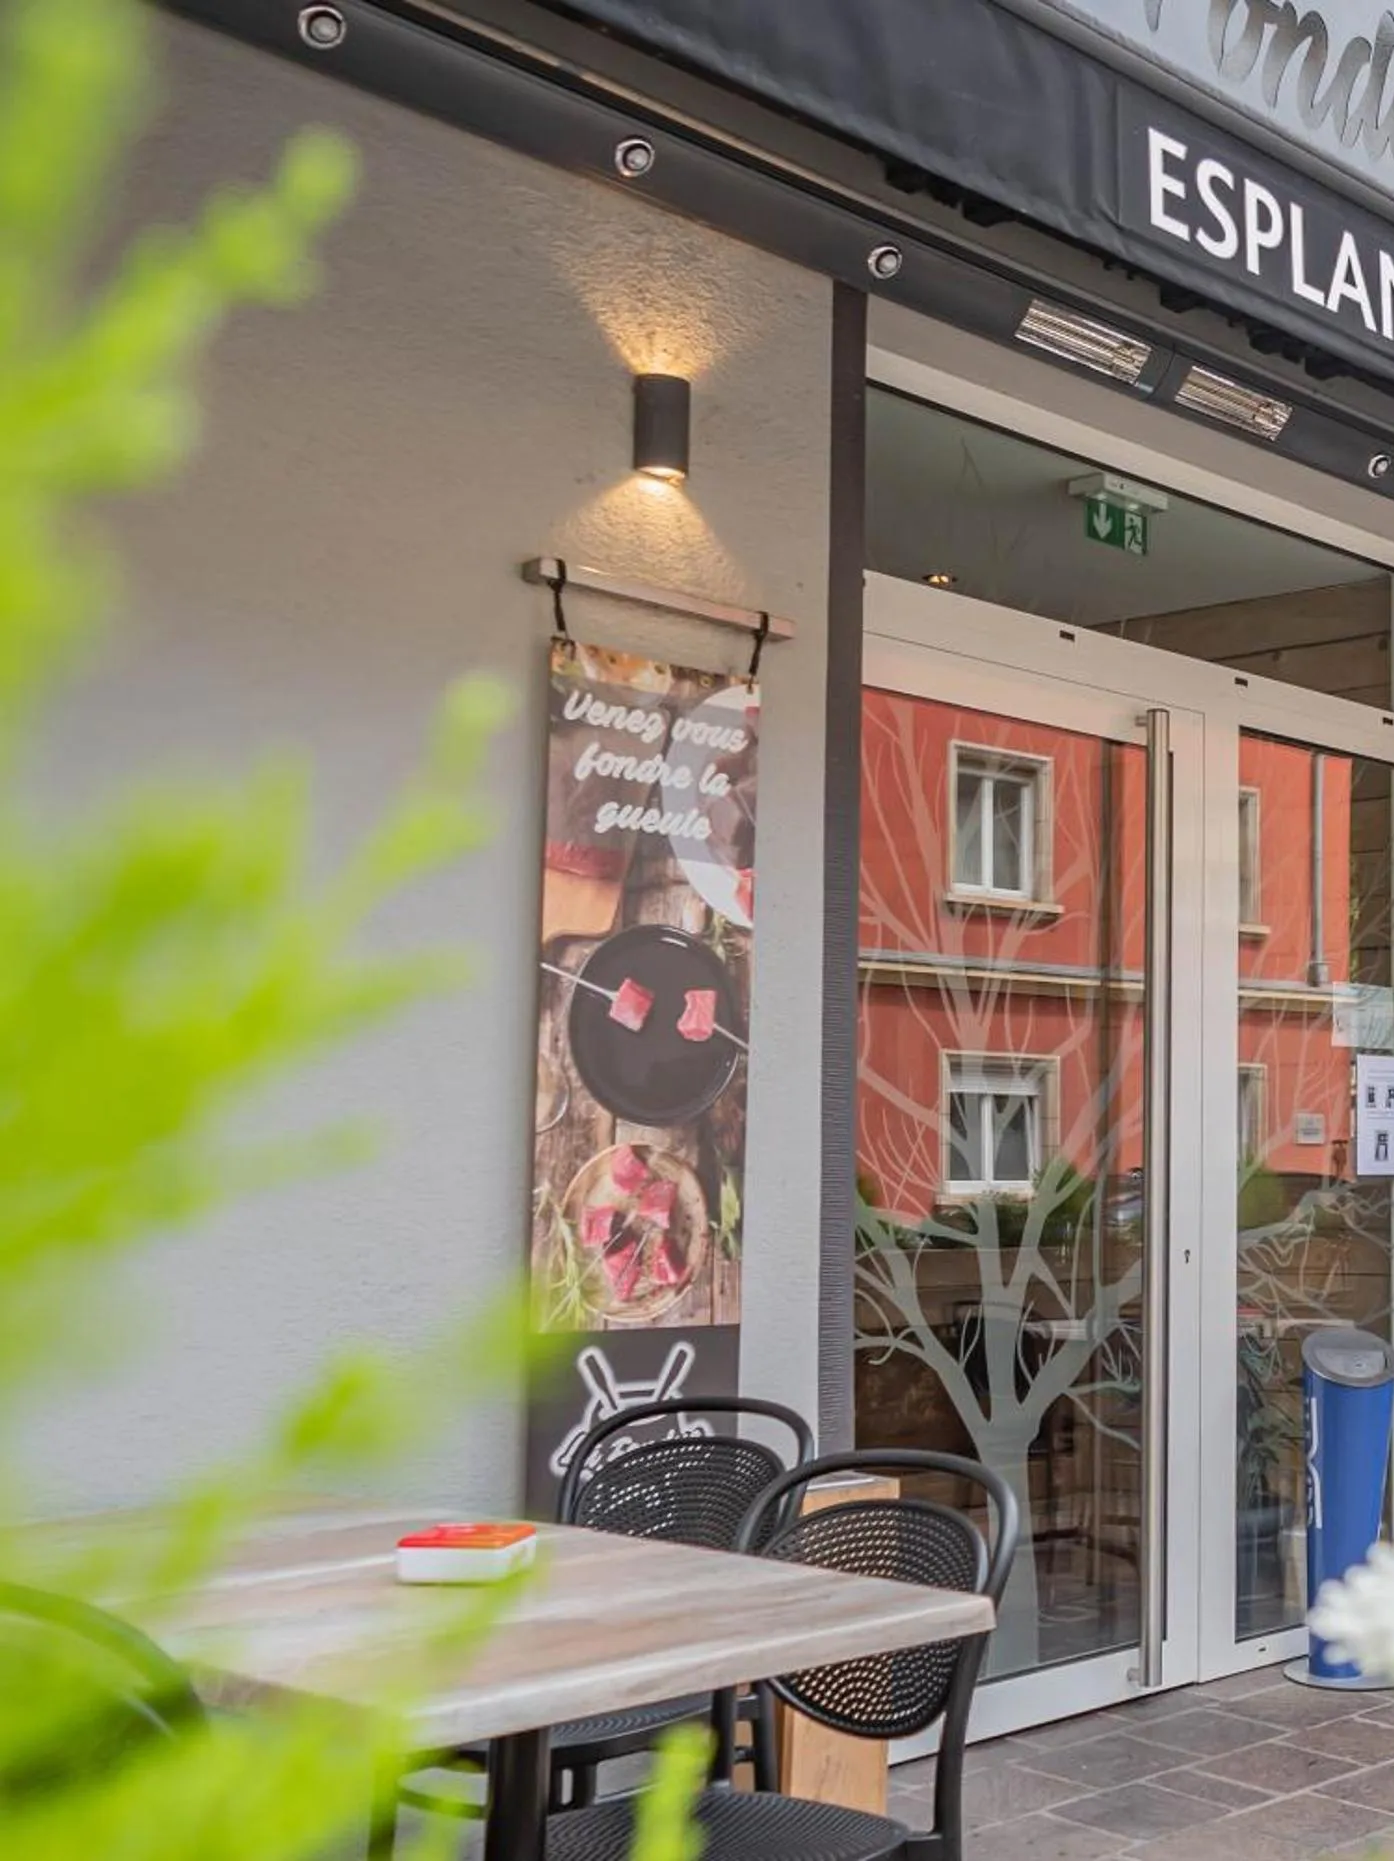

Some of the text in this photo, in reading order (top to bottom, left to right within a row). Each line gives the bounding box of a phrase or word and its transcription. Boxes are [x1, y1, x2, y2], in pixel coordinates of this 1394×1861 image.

[563, 690, 749, 752] Venez vous
[574, 742, 732, 797] fondre la
[594, 801, 712, 840] gueule
